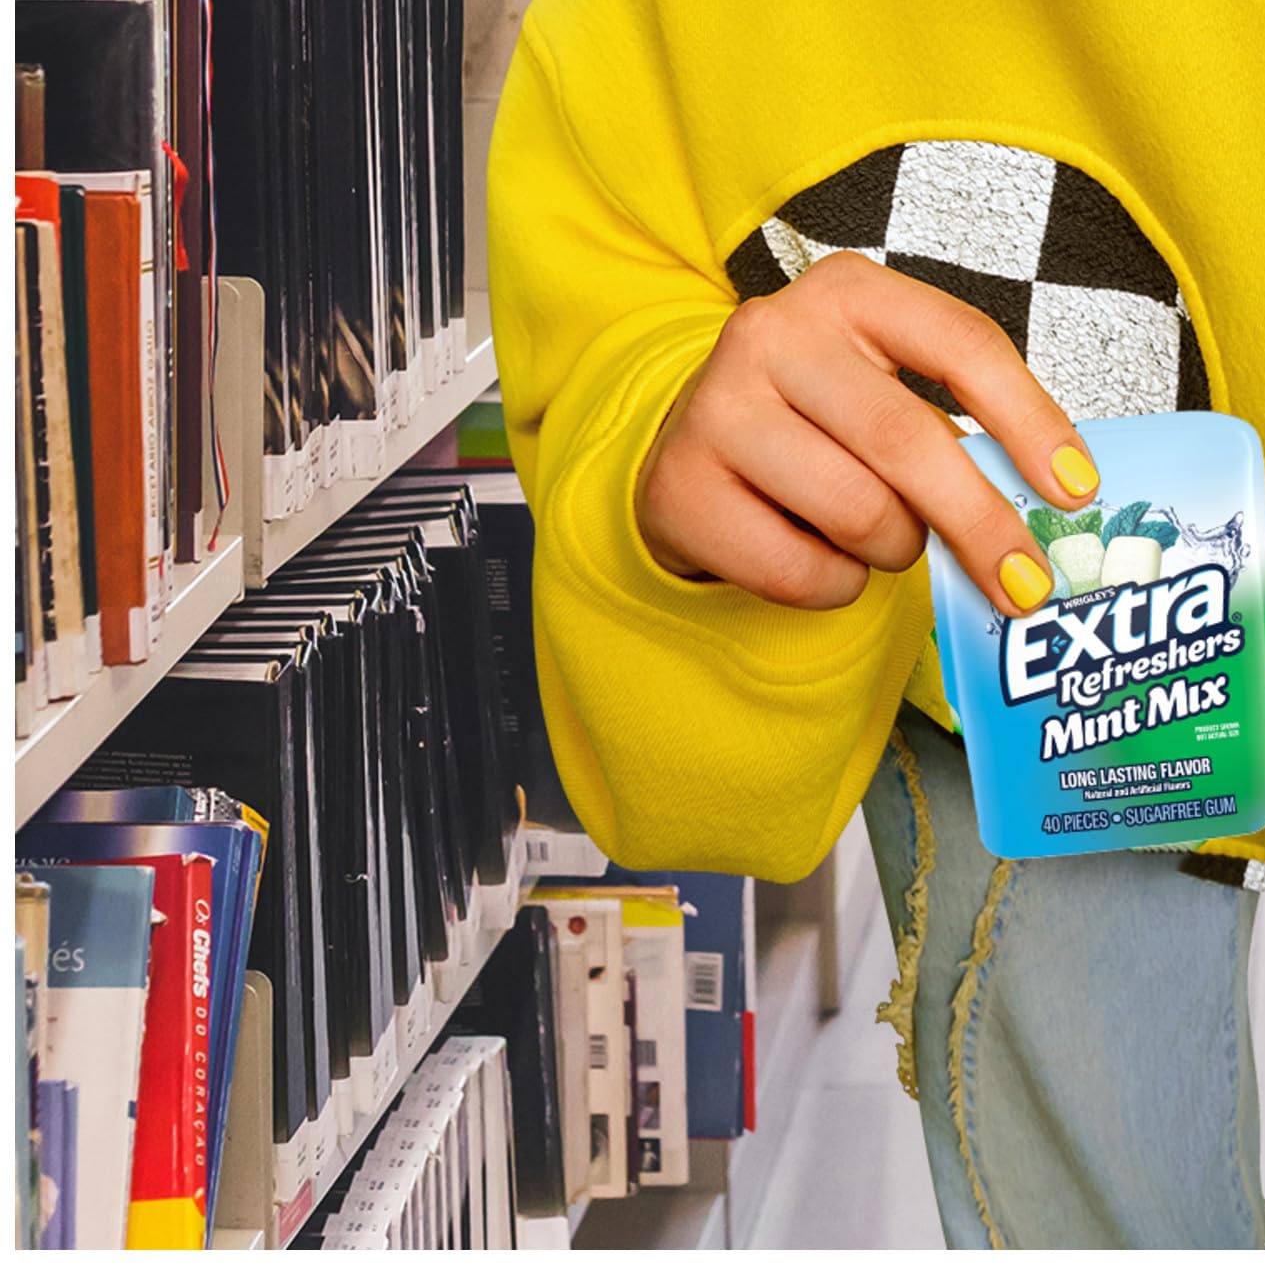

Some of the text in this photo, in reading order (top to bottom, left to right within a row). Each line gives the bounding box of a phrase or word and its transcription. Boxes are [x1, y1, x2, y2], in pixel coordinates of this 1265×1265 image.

[1062, 588, 1116, 610] WRIGLEY'S
[1006, 569, 1225, 701] Extra
[1061, 629, 1241, 707] Refreshers
[1043, 676, 1226, 759] Mint Mix
[1060, 757, 1211, 789] LONG LASTING FLAVOR
[1084, 781, 1191, 800] Natural and Artificial Flavors
[1043, 796, 1236, 833] 40 PIECES SUGARFREE GUM
[50, 940, 85, 973] és
[192, 928, 211, 999] Chefs
[195, 1006, 208, 1037] DO
